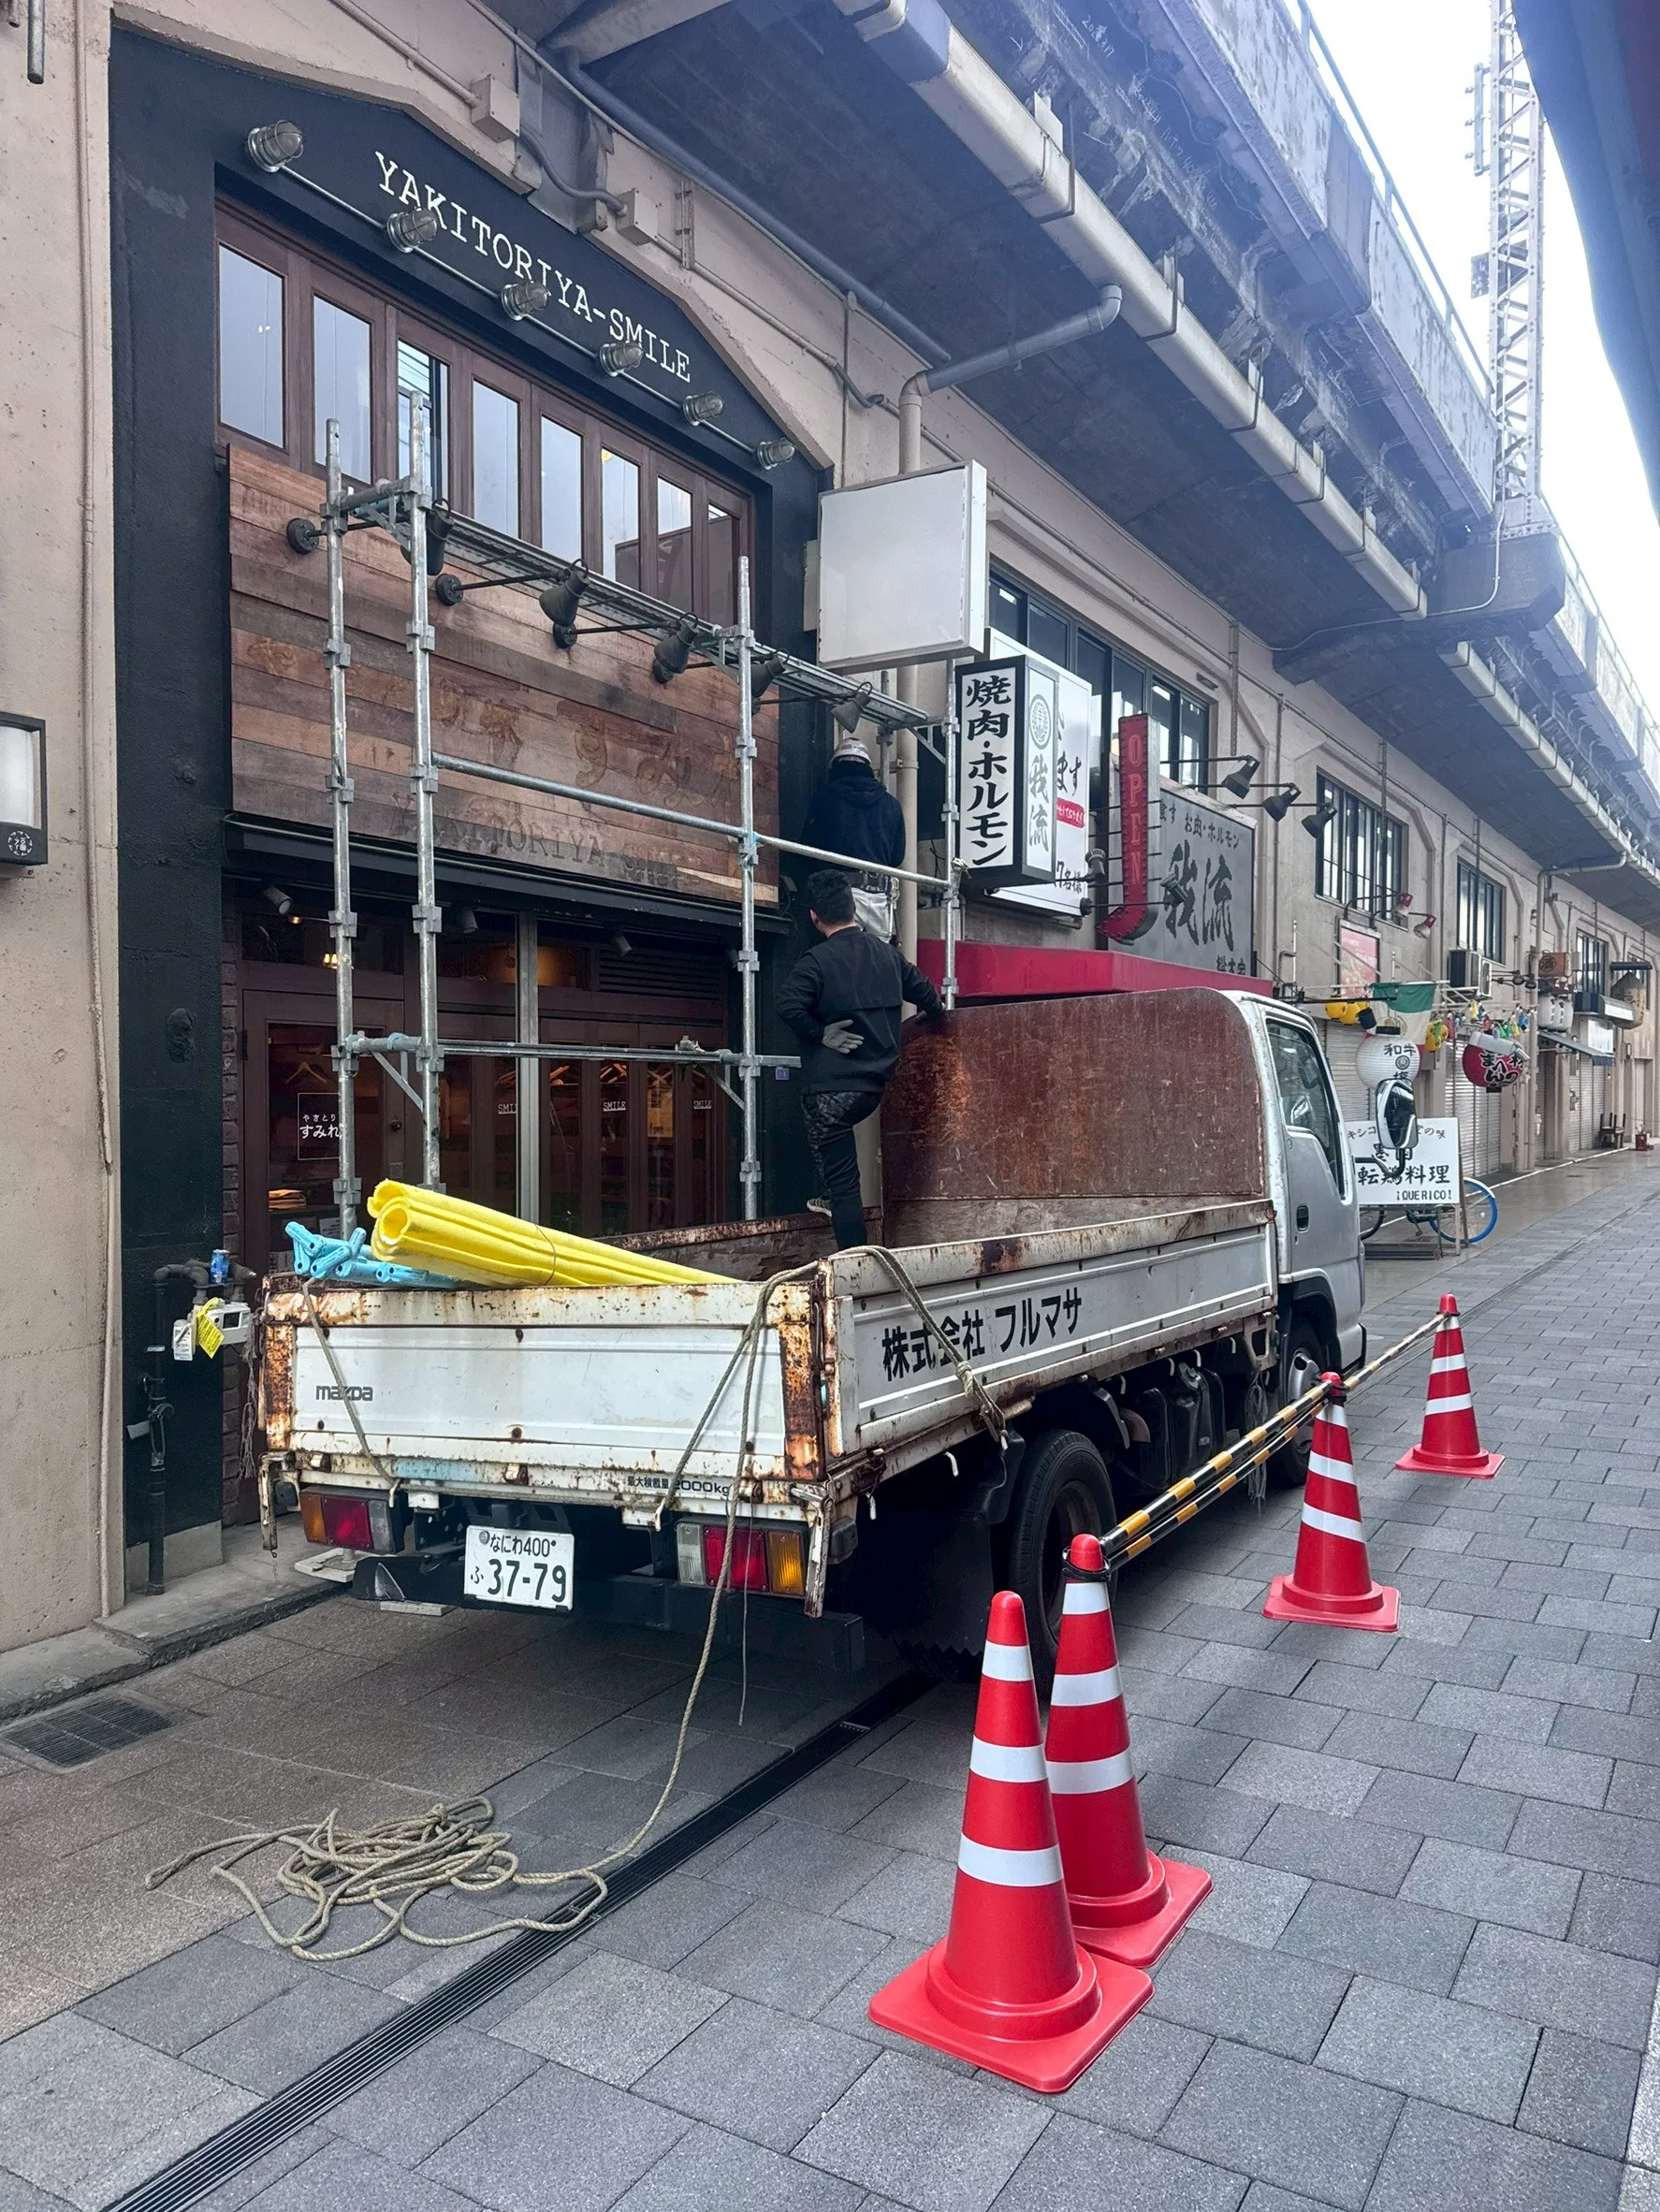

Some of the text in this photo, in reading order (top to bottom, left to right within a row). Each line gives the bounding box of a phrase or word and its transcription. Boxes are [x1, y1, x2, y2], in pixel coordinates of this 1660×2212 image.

[375, 151, 691, 383] YAKITORIYA-SMILE
[966, 675, 1012, 866] 焼肉・ホルモン
[1128, 734, 1143, 885] OPEN
[1383, 1043, 1417, 1056] 和牛
[498, 1104, 517, 1113] SMI
[602, 1100, 626, 1111] SMILE
[299, 1125, 342, 1139] すみれ
[881, 1287, 1082, 1382] 株式会社 フルマサ
[471, 1558, 566, 1603] ふ 37-79
